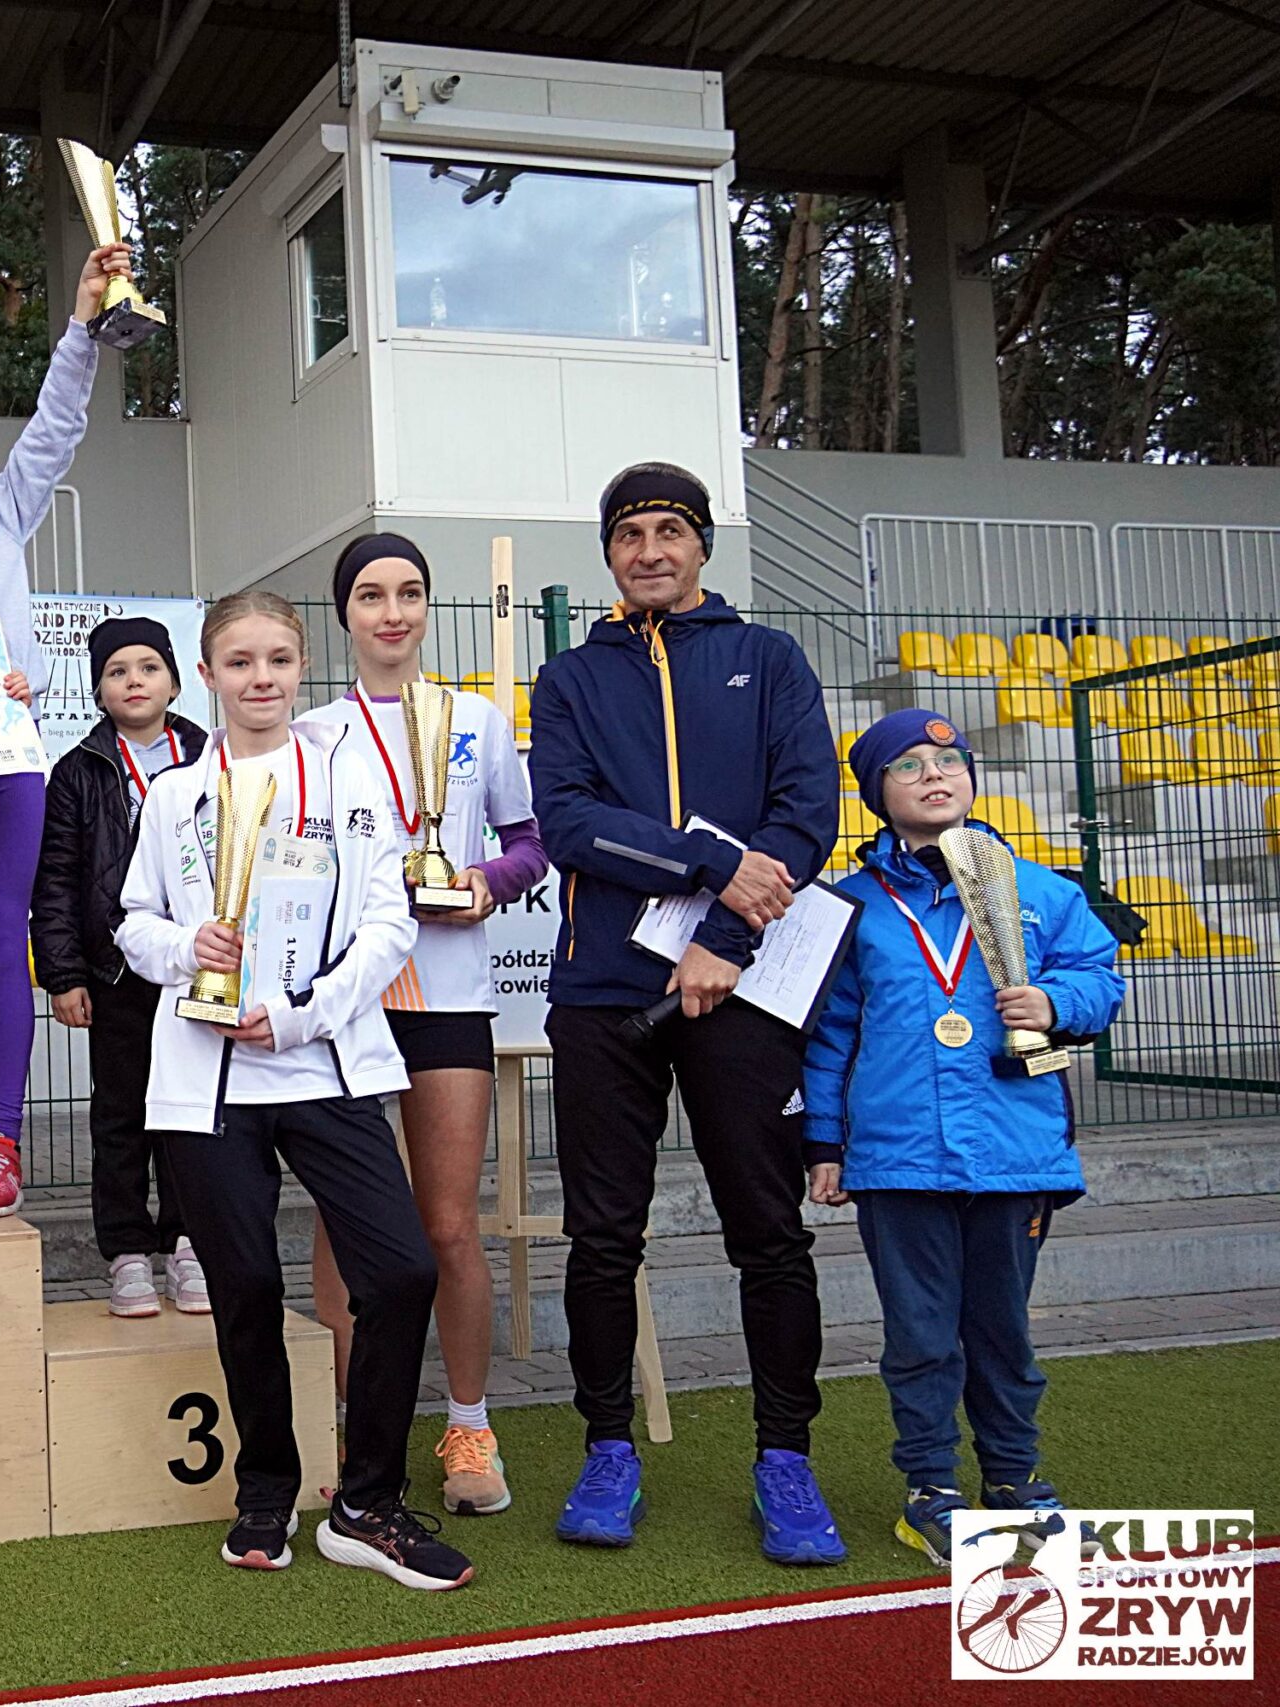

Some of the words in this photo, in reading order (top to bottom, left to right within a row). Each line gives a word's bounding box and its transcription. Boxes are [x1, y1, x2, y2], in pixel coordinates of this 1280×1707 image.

[32, 602, 101, 612] KKOATLETYCZNE
[48, 728, 64, 738] bieg
[304, 831, 332, 842] ZRYW
[287, 937, 297, 945] 1
[167, 1392, 224, 1486] 3
